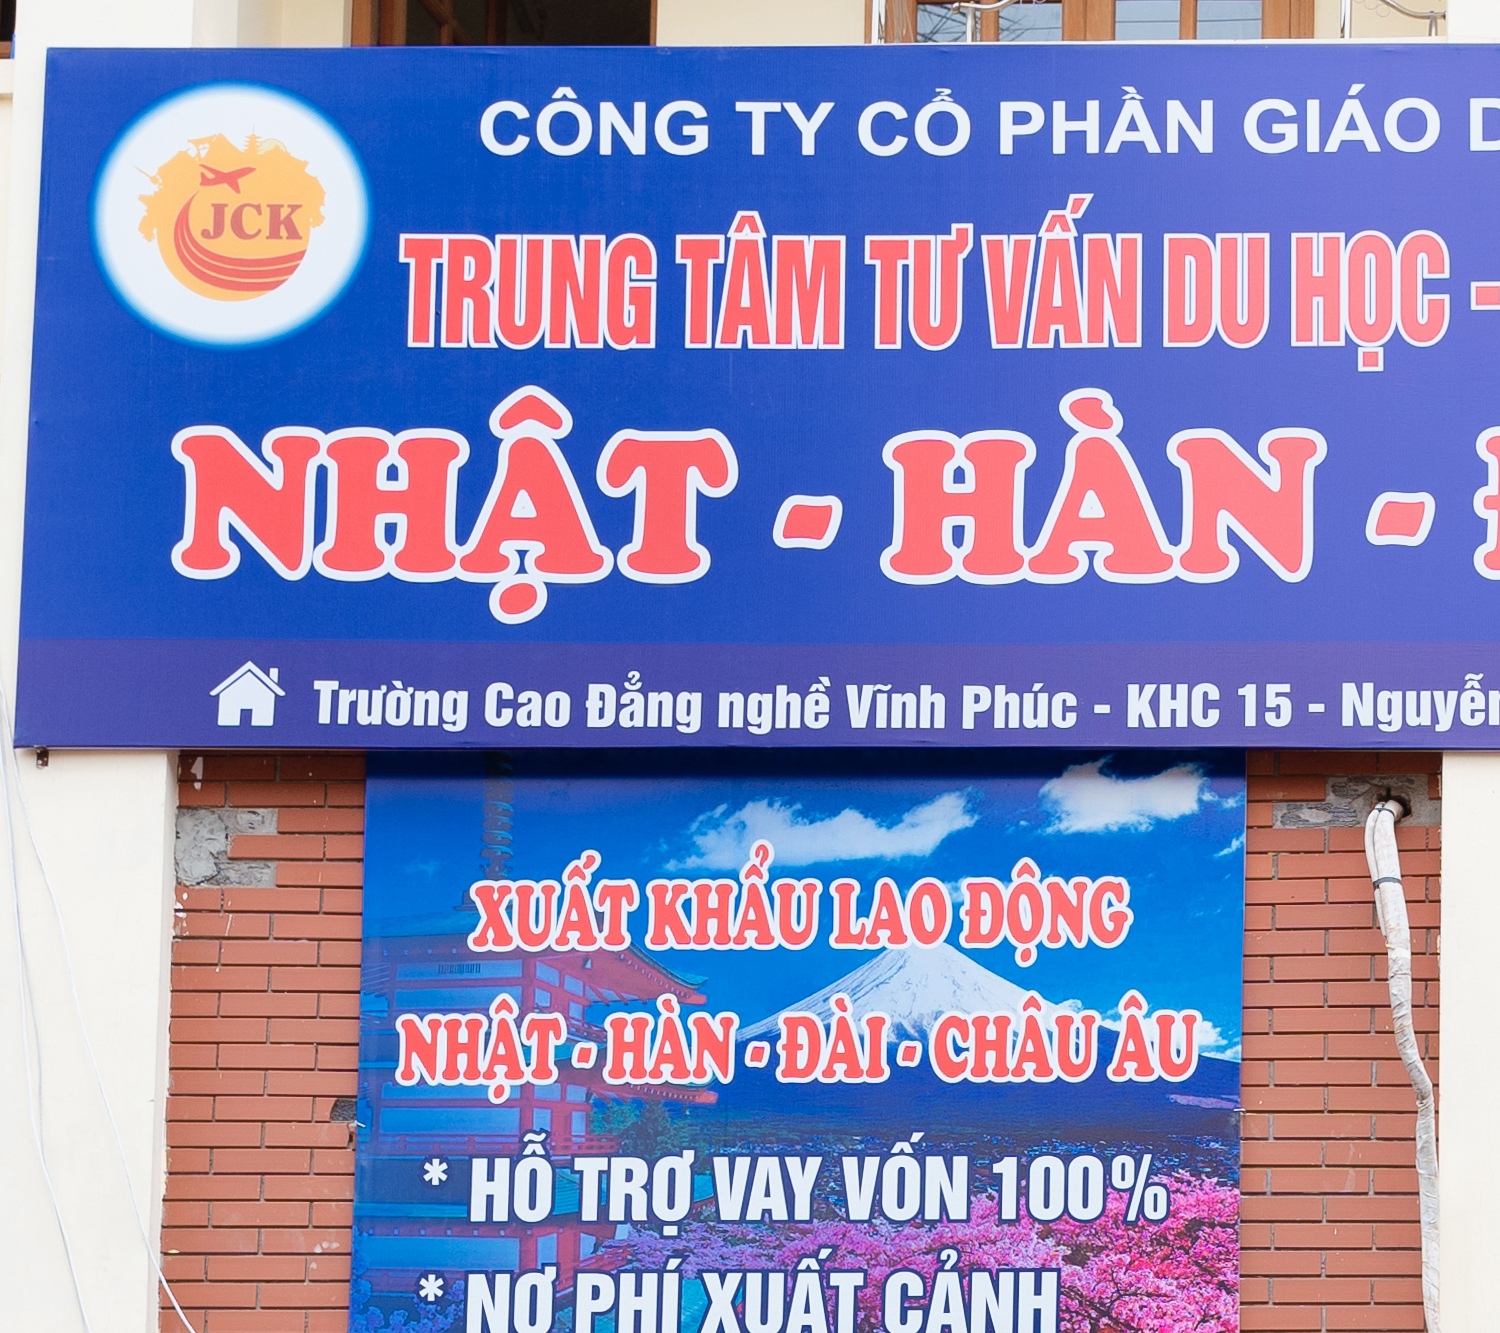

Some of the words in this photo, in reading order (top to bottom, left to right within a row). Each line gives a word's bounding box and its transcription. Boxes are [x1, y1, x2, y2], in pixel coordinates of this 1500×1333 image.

[480, 87, 708, 155] CÔNG
[736, 102, 834, 155] TY
[858, 86, 970, 156] CỔ
[1000, 85, 1213, 154] PHẦN
[1244, 84, 1440, 154] GIÁO
[200, 202, 304, 241] JCK
[399, 233, 657, 350] TRUNG
[676, 211, 846, 349] TÂM
[865, 223, 973, 351] TƯ
[981, 193, 1142, 349] VẤN
[1163, 233, 1270, 349] DU
[1291, 230, 1450, 372] HỌC
[171, 385, 738, 624] NHẬT
[880, 388, 1327, 585] HÀN
[314, 680, 468, 731] Trường
[485, 682, 570, 727] Cao
[586, 671, 702, 733] Đẳng
[718, 677, 830, 734] nghề
[846, 684, 945, 728] Vĩnh
[963, 683, 1077, 729] Phúc
[1127, 683, 1220, 727] KHC
[1238, 684, 1292, 727] 15
[467, 850, 639, 952] XUẤT
[647, 839, 823, 951] KHẨU
[830, 878, 953, 949] LAO
[960, 857, 1130, 968] ĐỘNG
[394, 992, 568, 1103] NHẬT
[603, 993, 736, 1085] HÀN
[776, 992, 891, 1085] ĐÀI
[927, 993, 1098, 1082] CHÂU
[1107, 991, 1199, 1082] ÂU
[470, 1130, 555, 1223] HỖ
[573, 1149, 695, 1236] TRỢ
[712, 1156, 821, 1223] VAY
[843, 1131, 970, 1223] VỐN
[991, 1152, 1170, 1224] 100%
